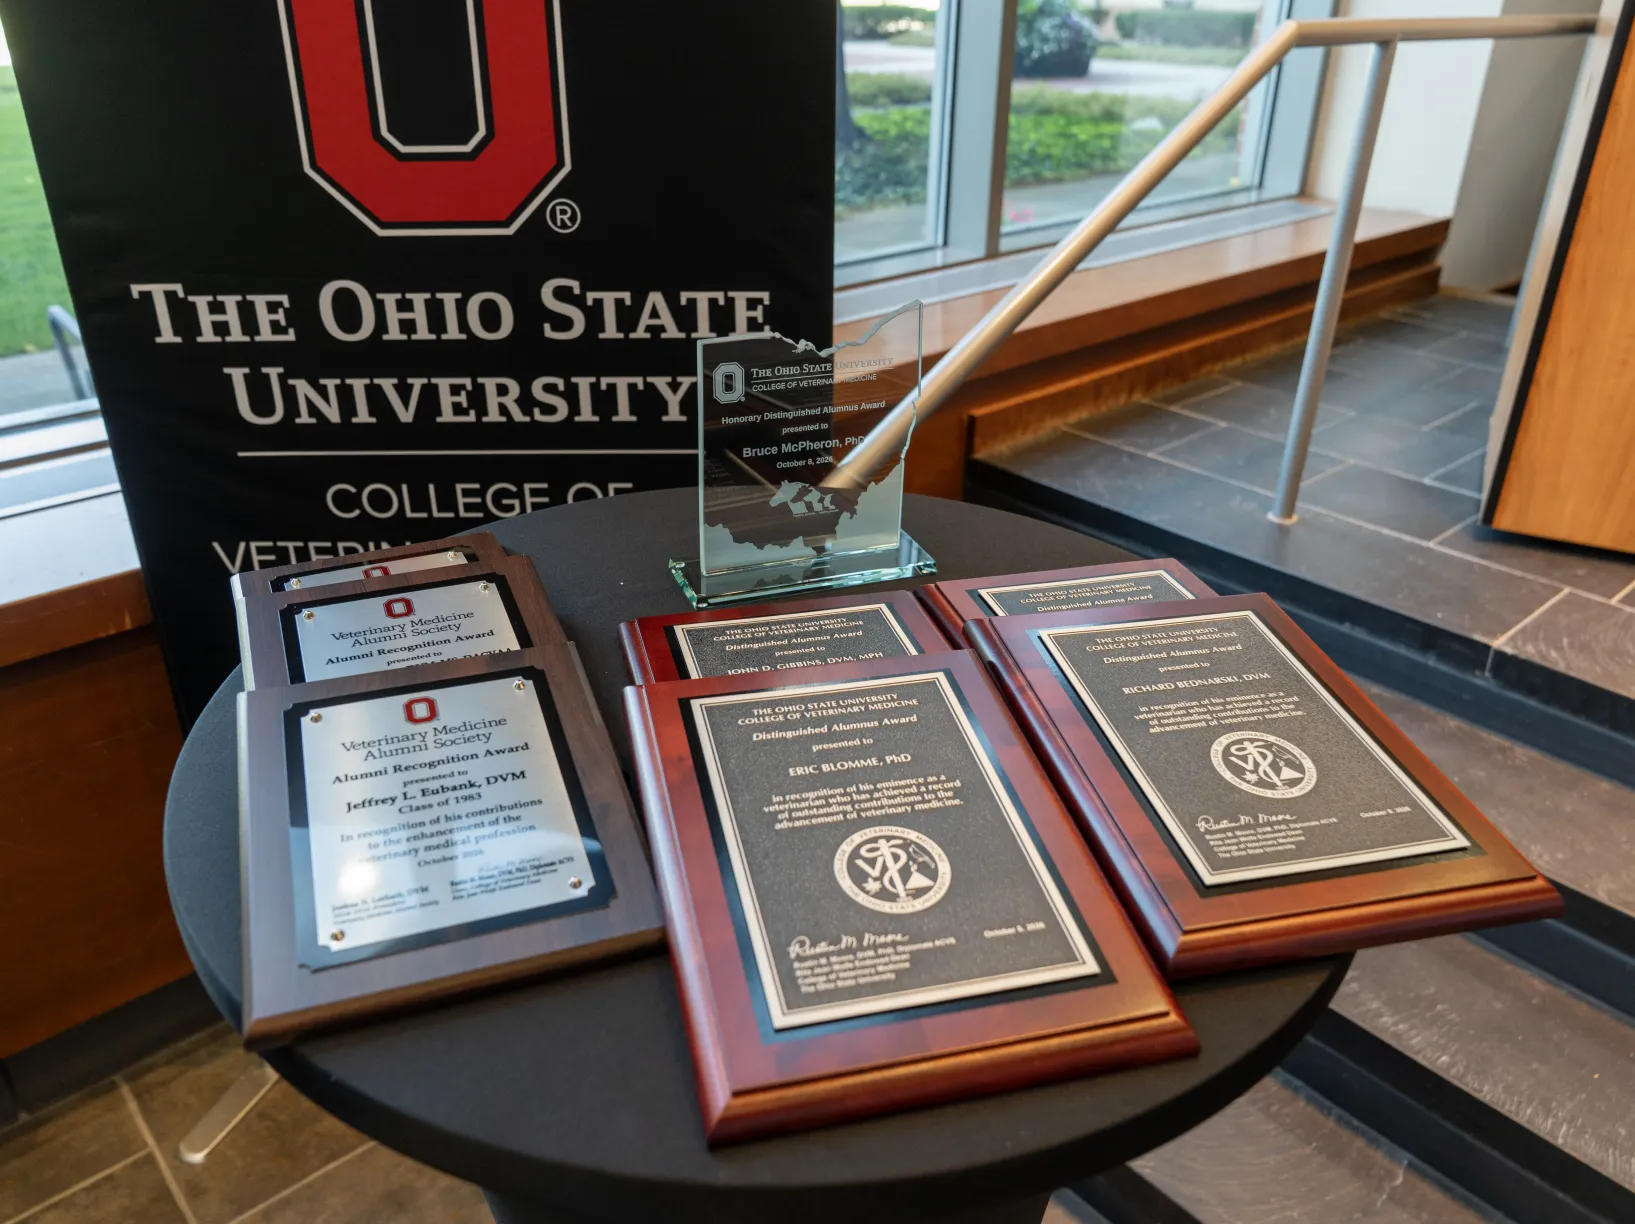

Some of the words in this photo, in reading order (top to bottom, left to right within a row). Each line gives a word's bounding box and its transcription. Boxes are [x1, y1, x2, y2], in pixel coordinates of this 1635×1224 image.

[130, 283, 296, 344] THE
[319, 279, 515, 342] OHIO
[542, 277, 771, 341] STATE
[750, 368, 771, 377] THE
[774, 366, 799, 375] OHIO
[802, 363, 831, 372] STATE
[836, 358, 893, 369] UNIVERSITY
[223, 367, 697, 425] UNIVERSITY
[752, 382, 785, 391] COLLEGE
[721, 414, 761, 424] Honorary
[763, 407, 820, 419] Distinguished
[822, 404, 858, 413] Alumnus
[860, 400, 885, 409] Award
[782, 423, 818, 434] presented
[742, 446, 777, 457] Bruce
[781, 439, 841, 452] McPheron,
[776, 460, 805, 468] October
[816, 455, 833, 463] 2026
[326, 482, 550, 519] COLLEGE
[1091, 582, 1136, 590] UNIVERSITY
[1034, 601, 1093, 611] Distinguished
[331, 624, 406, 639] Veterinary
[409, 612, 474, 627] Medicine
[768, 626, 819, 634] VETERINARY
[821, 620, 864, 628] MEDICINE
[797, 618, 846, 626] UNIVERSITY
[1167, 627, 1218, 636] UNIVERSITY
[350, 630, 407, 646] Alumni
[410, 623, 462, 636] Society
[724, 640, 788, 650] Distinguished
[832, 630, 863, 638] Award
[1085, 643, 1126, 651] COLLEGE
[1141, 636, 1194, 645] VETERINARY
[1194, 631, 1238, 639] MEDICINE
[325, 650, 373, 664] Alumni
[376, 639, 451, 655] Recognition
[454, 629, 495, 642] Award
[774, 646, 815, 656] presented
[1102, 652, 1168, 663] Distinguished
[1168, 648, 1211, 656] Alumnus
[1210, 643, 1243, 652] Award
[386, 652, 431, 666] presented
[776, 659, 824, 669] GIBBINS,
[1157, 662, 1200, 672] presented
[1121, 682, 1176, 693] RICHARD
[1175, 676, 1243, 687] BEDNARSKI,
[1241, 672, 1271, 680] DVM
[737, 714, 784, 724] COLLEGE
[803, 705, 866, 717] VETERINARY
[867, 699, 918, 709] MEDICINE
[752, 707, 773, 715] THE
[774, 704, 805, 712] OHIO
[807, 700, 837, 709] STATE
[839, 693, 898, 705] UNIVERSITY
[341, 731, 428, 750] Veterinary
[432, 718, 507, 735] Medicine
[752, 725, 828, 740] Distinguished
[830, 721, 879, 730] Alumnus
[881, 714, 918, 724] Award
[363, 740, 428, 760] Alumni
[433, 732, 492, 748] Society
[811, 738, 861, 751] presented
[332, 766, 388, 783] Alumni
[392, 753, 479, 772] Recognition
[483, 742, 530, 756] Award
[788, 764, 818, 776] ERIC
[820, 757, 883, 771] BLOMME,
[884, 753, 912, 763] PhD
[402, 771, 455, 787] presented
[771, 794, 784, 802] in
[785, 788, 844, 800] recognition
[846, 784, 858, 794] of
[858, 782, 874, 790] his
[876, 777, 925, 788] eminence
[346, 796, 398, 811] Jeffrey
[401, 791, 416, 800] L.
[420, 780, 482, 796] Eubank,
[485, 770, 526, 784] DVM
[763, 799, 825, 811] veterinarian
[827, 795, 850, 803] who
[872, 785, 918, 797] achieved
[927, 779, 961, 790] record
[398, 803, 433, 813] Class
[436, 797, 449, 806] of
[454, 792, 482, 803] 1983
[774, 814, 844, 828] advancement
[846, 811, 858, 819] of
[860, 806, 912, 816] veterinary
[913, 798, 964, 809] medicine.
[777, 811, 789, 821] of
[791, 804, 852, 816] outstanding
[854, 795, 922, 808] contributions
[340, 834, 353, 842] In
[358, 820, 426, 840] recognition
[429, 815, 442, 825] of
[444, 814, 462, 822] his
[465, 799, 543, 817] contributions
[382, 838, 402, 846] the
[405, 821, 485, 841] enhancement
[488, 816, 500, 825] of
[502, 815, 521, 823] the
[358, 847, 422, 863] terinary
[423, 838, 468, 851] medical
[474, 822, 537, 843] profession
